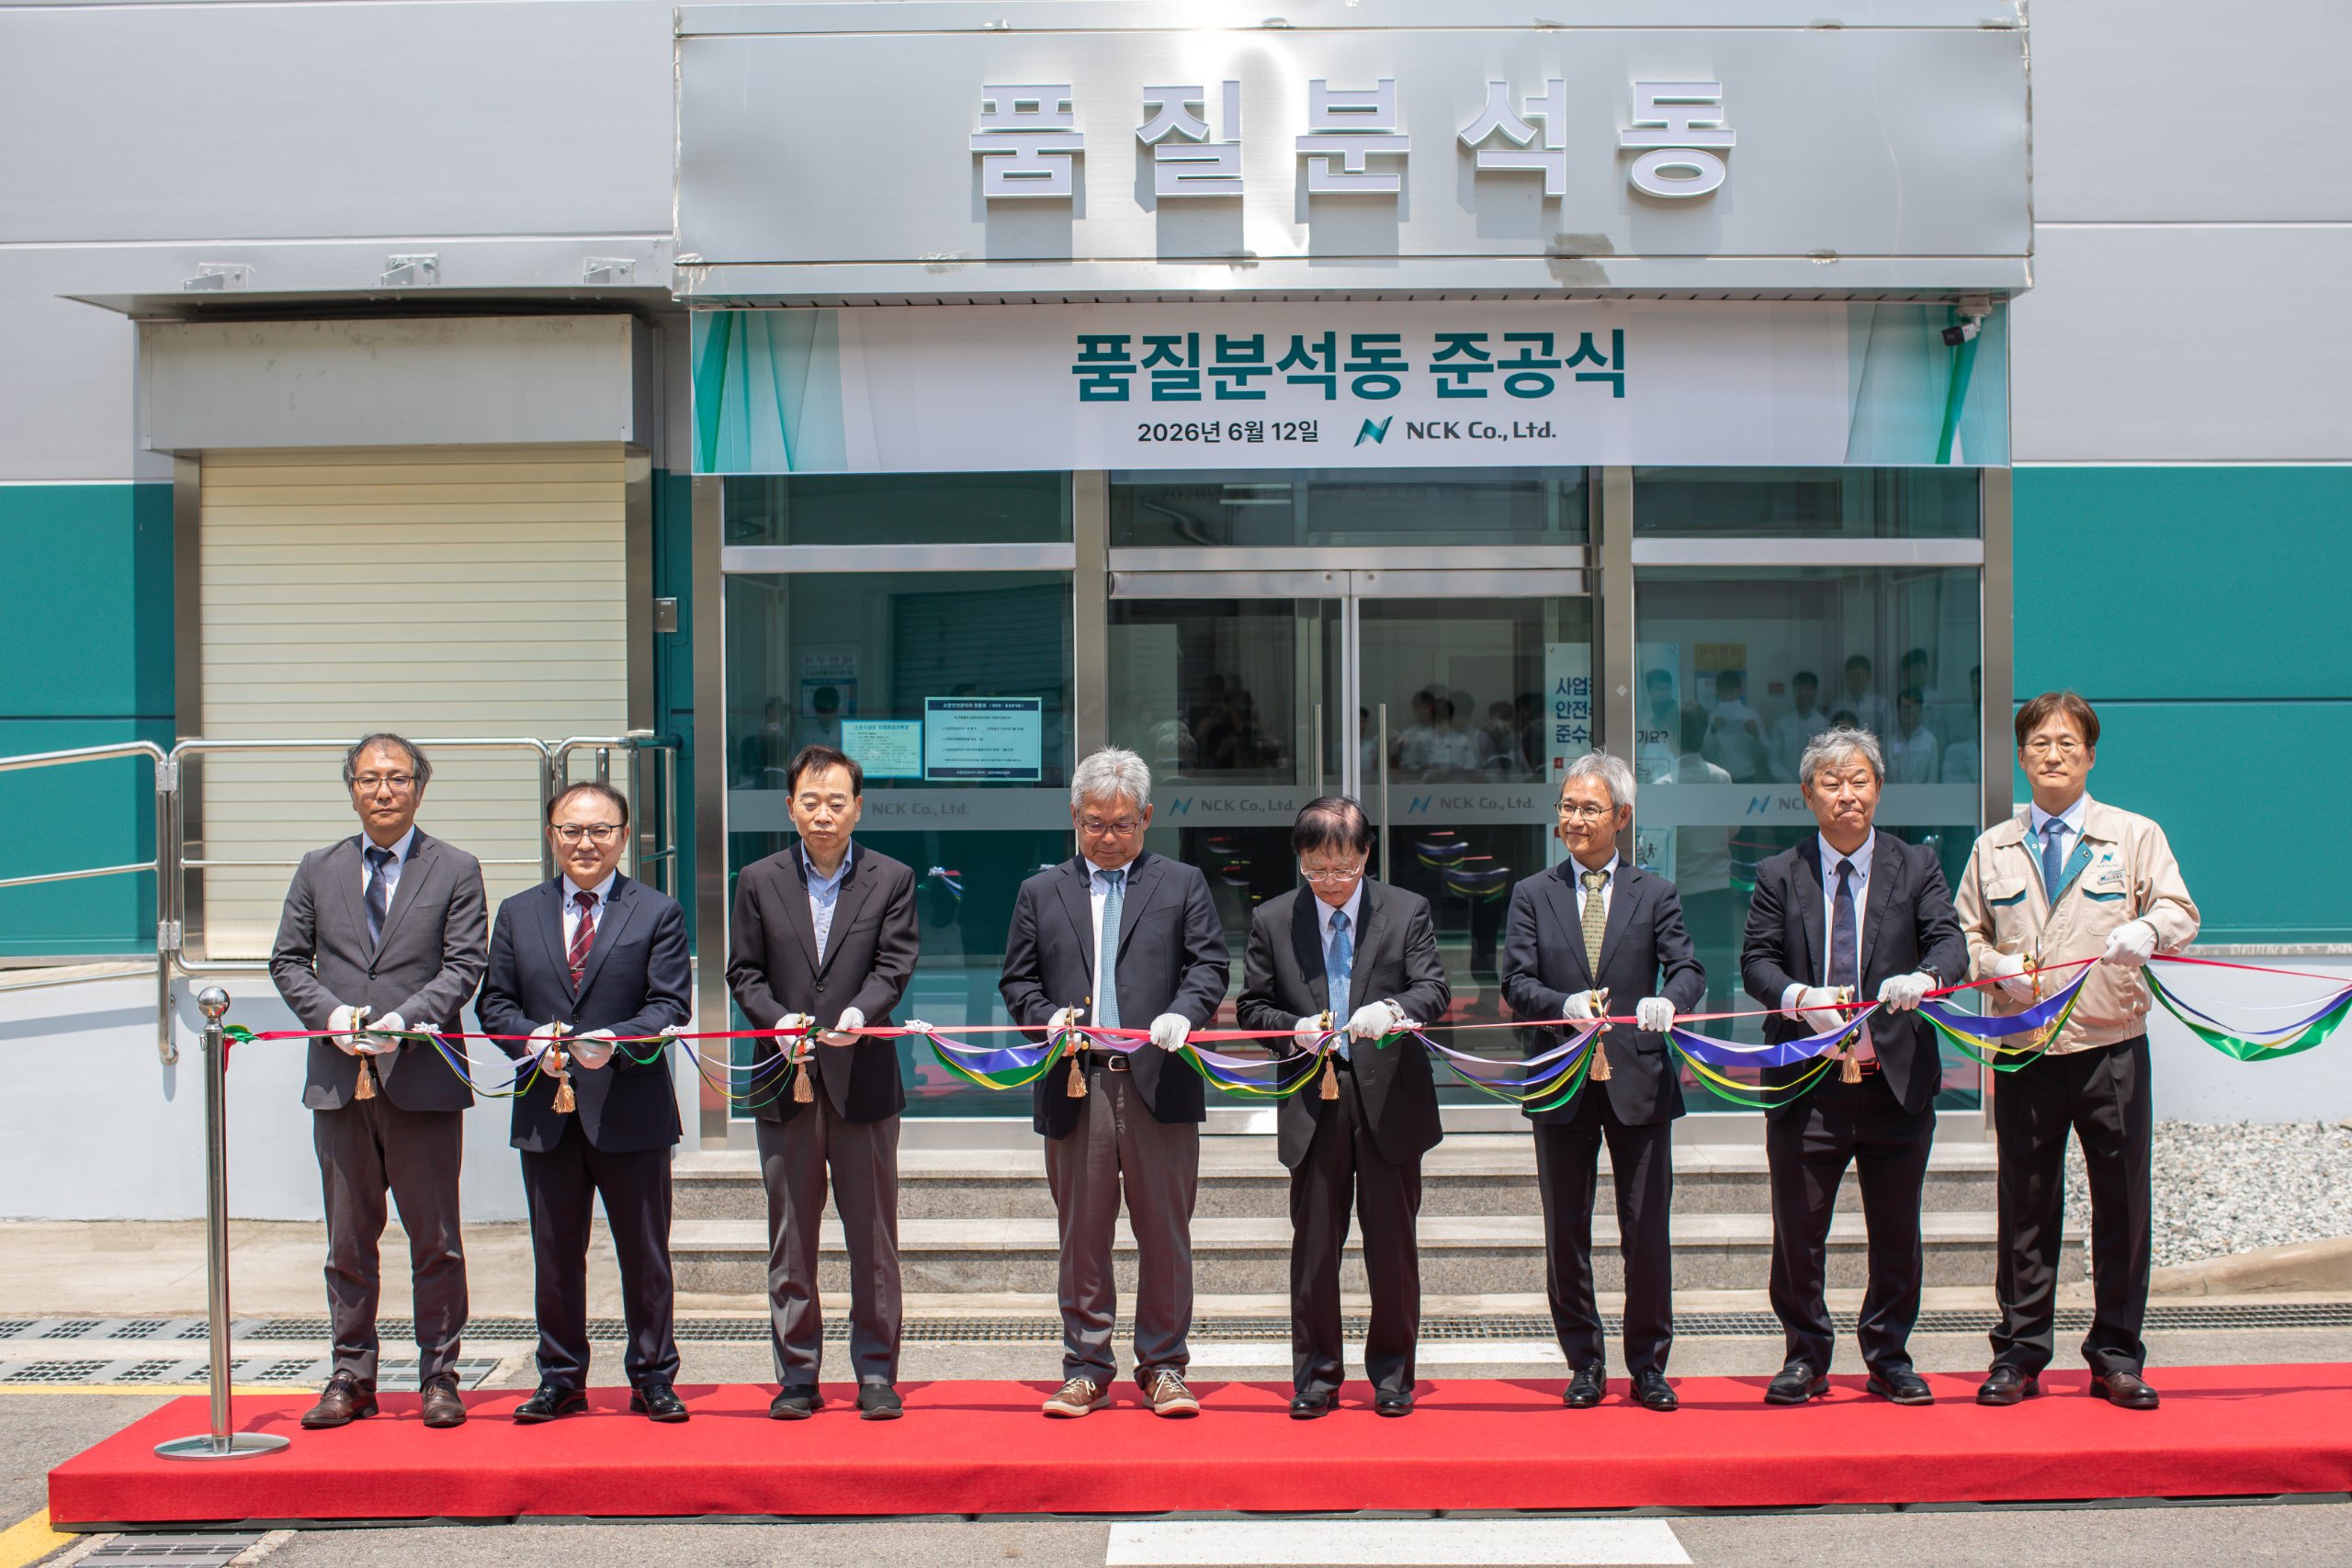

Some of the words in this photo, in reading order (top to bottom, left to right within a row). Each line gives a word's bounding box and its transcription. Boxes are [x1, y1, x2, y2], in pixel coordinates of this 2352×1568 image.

[969, 78, 1736, 199] 품질분석동
[1071, 331, 1409, 402] 품질분석동
[1429, 328, 1625, 400] 준공식
[1137, 420, 1220, 443] 2026년
[1227, 420, 1264, 443] 6월
[1272, 420, 1318, 443] 12일
[1406, 421, 1461, 439] NCK
[1468, 421, 1508, 442] Co.,
[1512, 421, 1557, 439] Ltd.
[1555, 676, 1591, 696] 사업
[1555, 700, 1591, 720] 안전
[872, 802, 907, 816] NCK
[911, 802, 938, 817] Co.,
[941, 802, 969, 815] Ltd.
[1200, 799, 1236, 811] NCK
[1239, 799, 1265, 813] Co.,
[1268, 798, 1296, 811] Ltd.
[1439, 796, 1475, 809] NCK
[1478, 796, 1505, 811] Co.,
[1507, 796, 1535, 809] Ltd.
